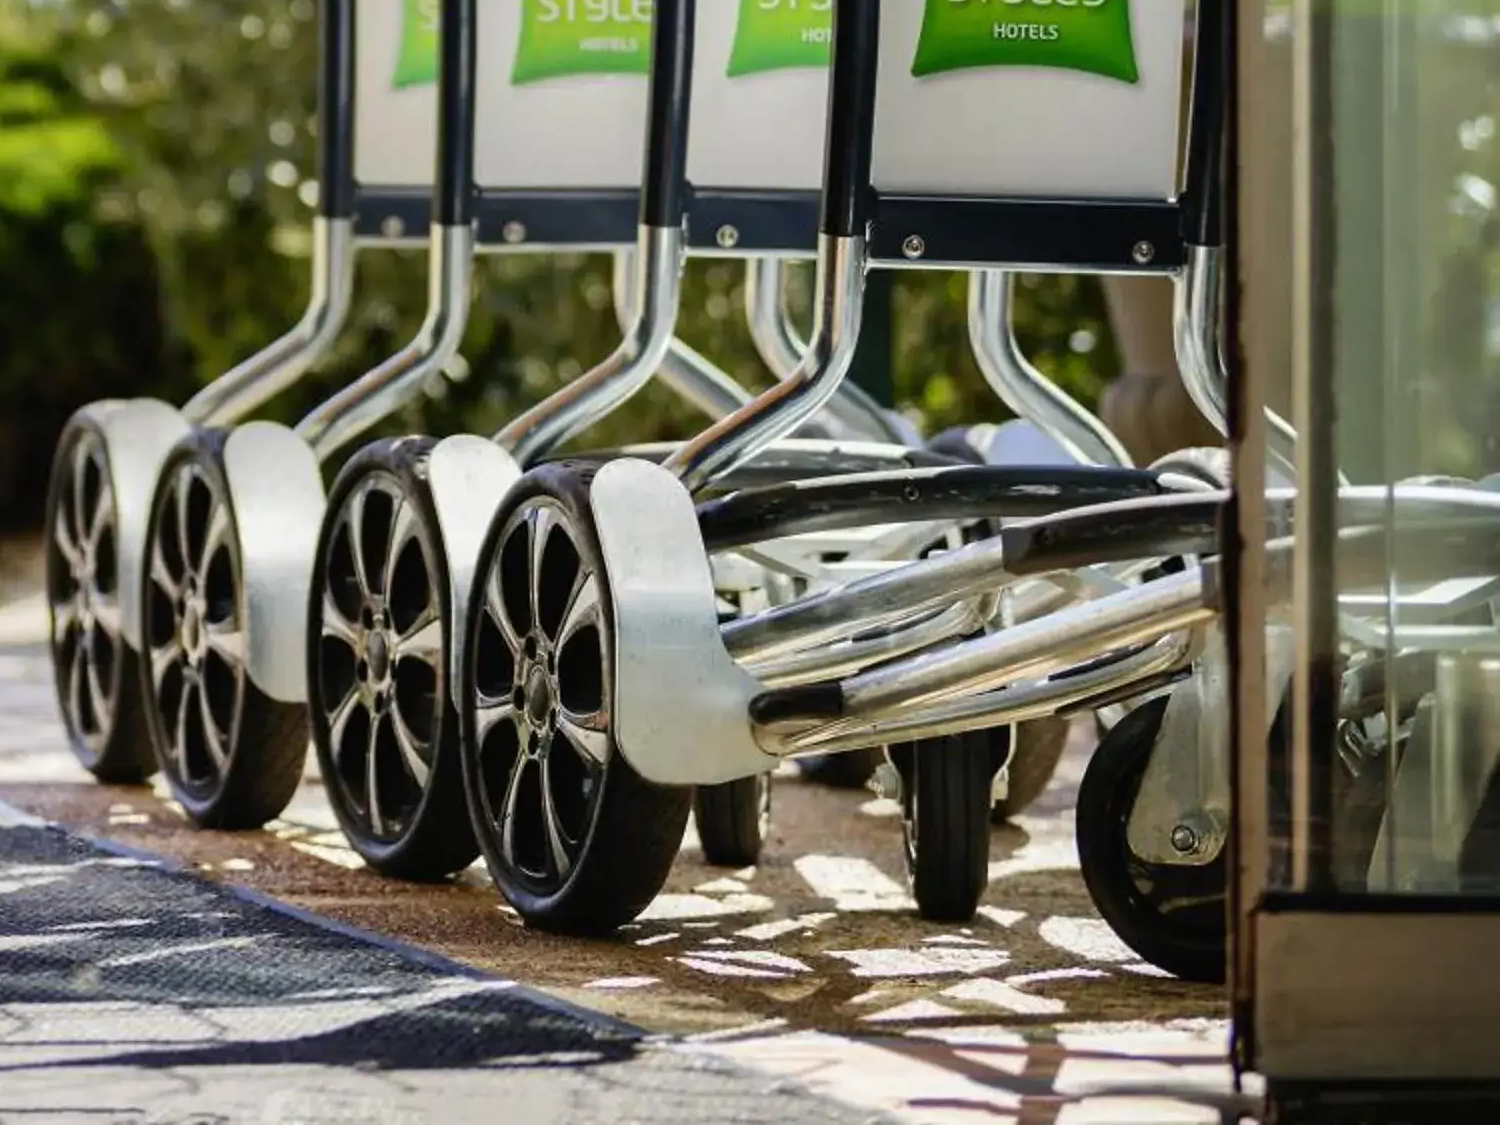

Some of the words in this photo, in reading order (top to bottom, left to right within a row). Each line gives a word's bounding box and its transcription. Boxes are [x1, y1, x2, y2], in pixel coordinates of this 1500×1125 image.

[801, 26, 833, 43] HOT
[993, 22, 1059, 40] HOTELS
[578, 36, 639, 53] TLS
